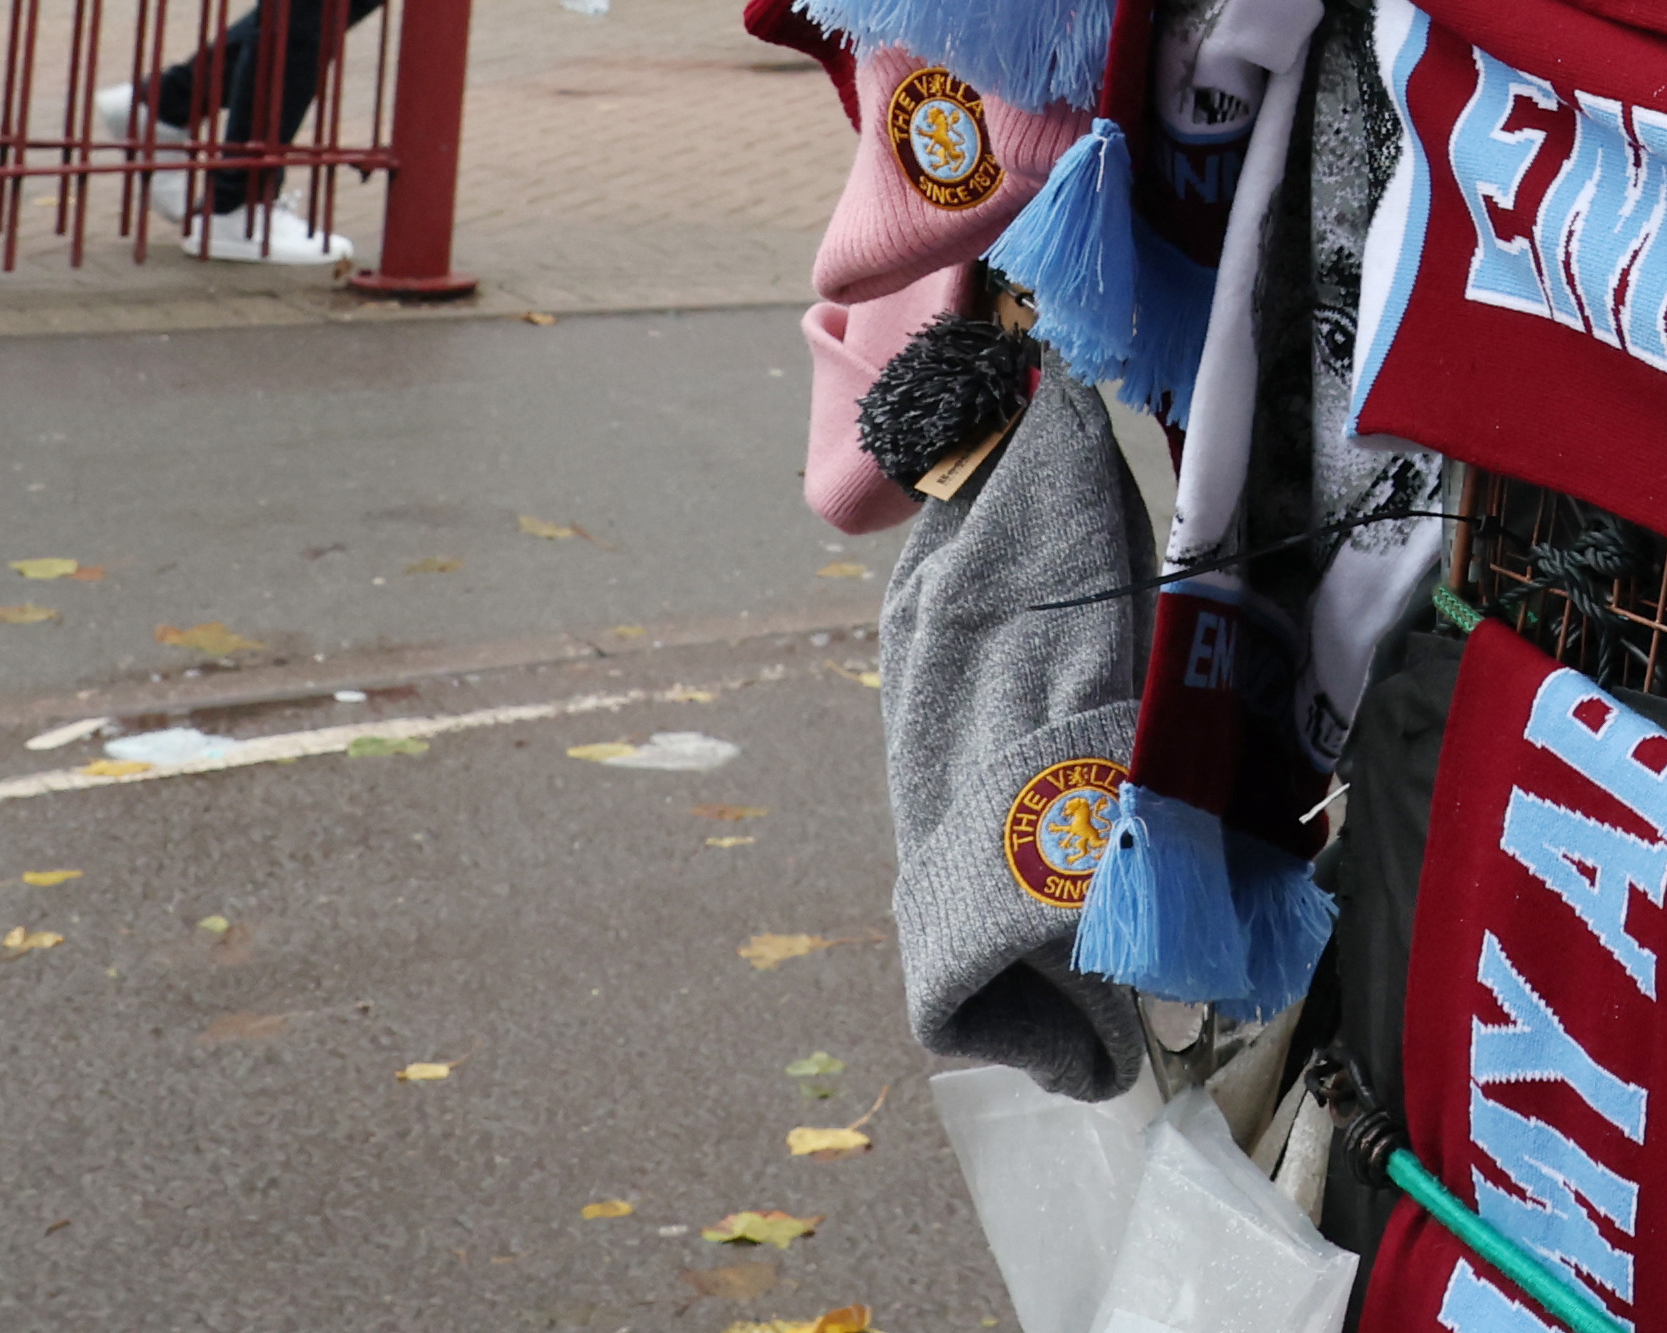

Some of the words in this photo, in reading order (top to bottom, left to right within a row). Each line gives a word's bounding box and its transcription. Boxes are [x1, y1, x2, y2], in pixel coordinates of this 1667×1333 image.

[893, 91, 916, 144] THE
[918, 175, 972, 205] SINCE
[1012, 790, 1048, 853] THE
